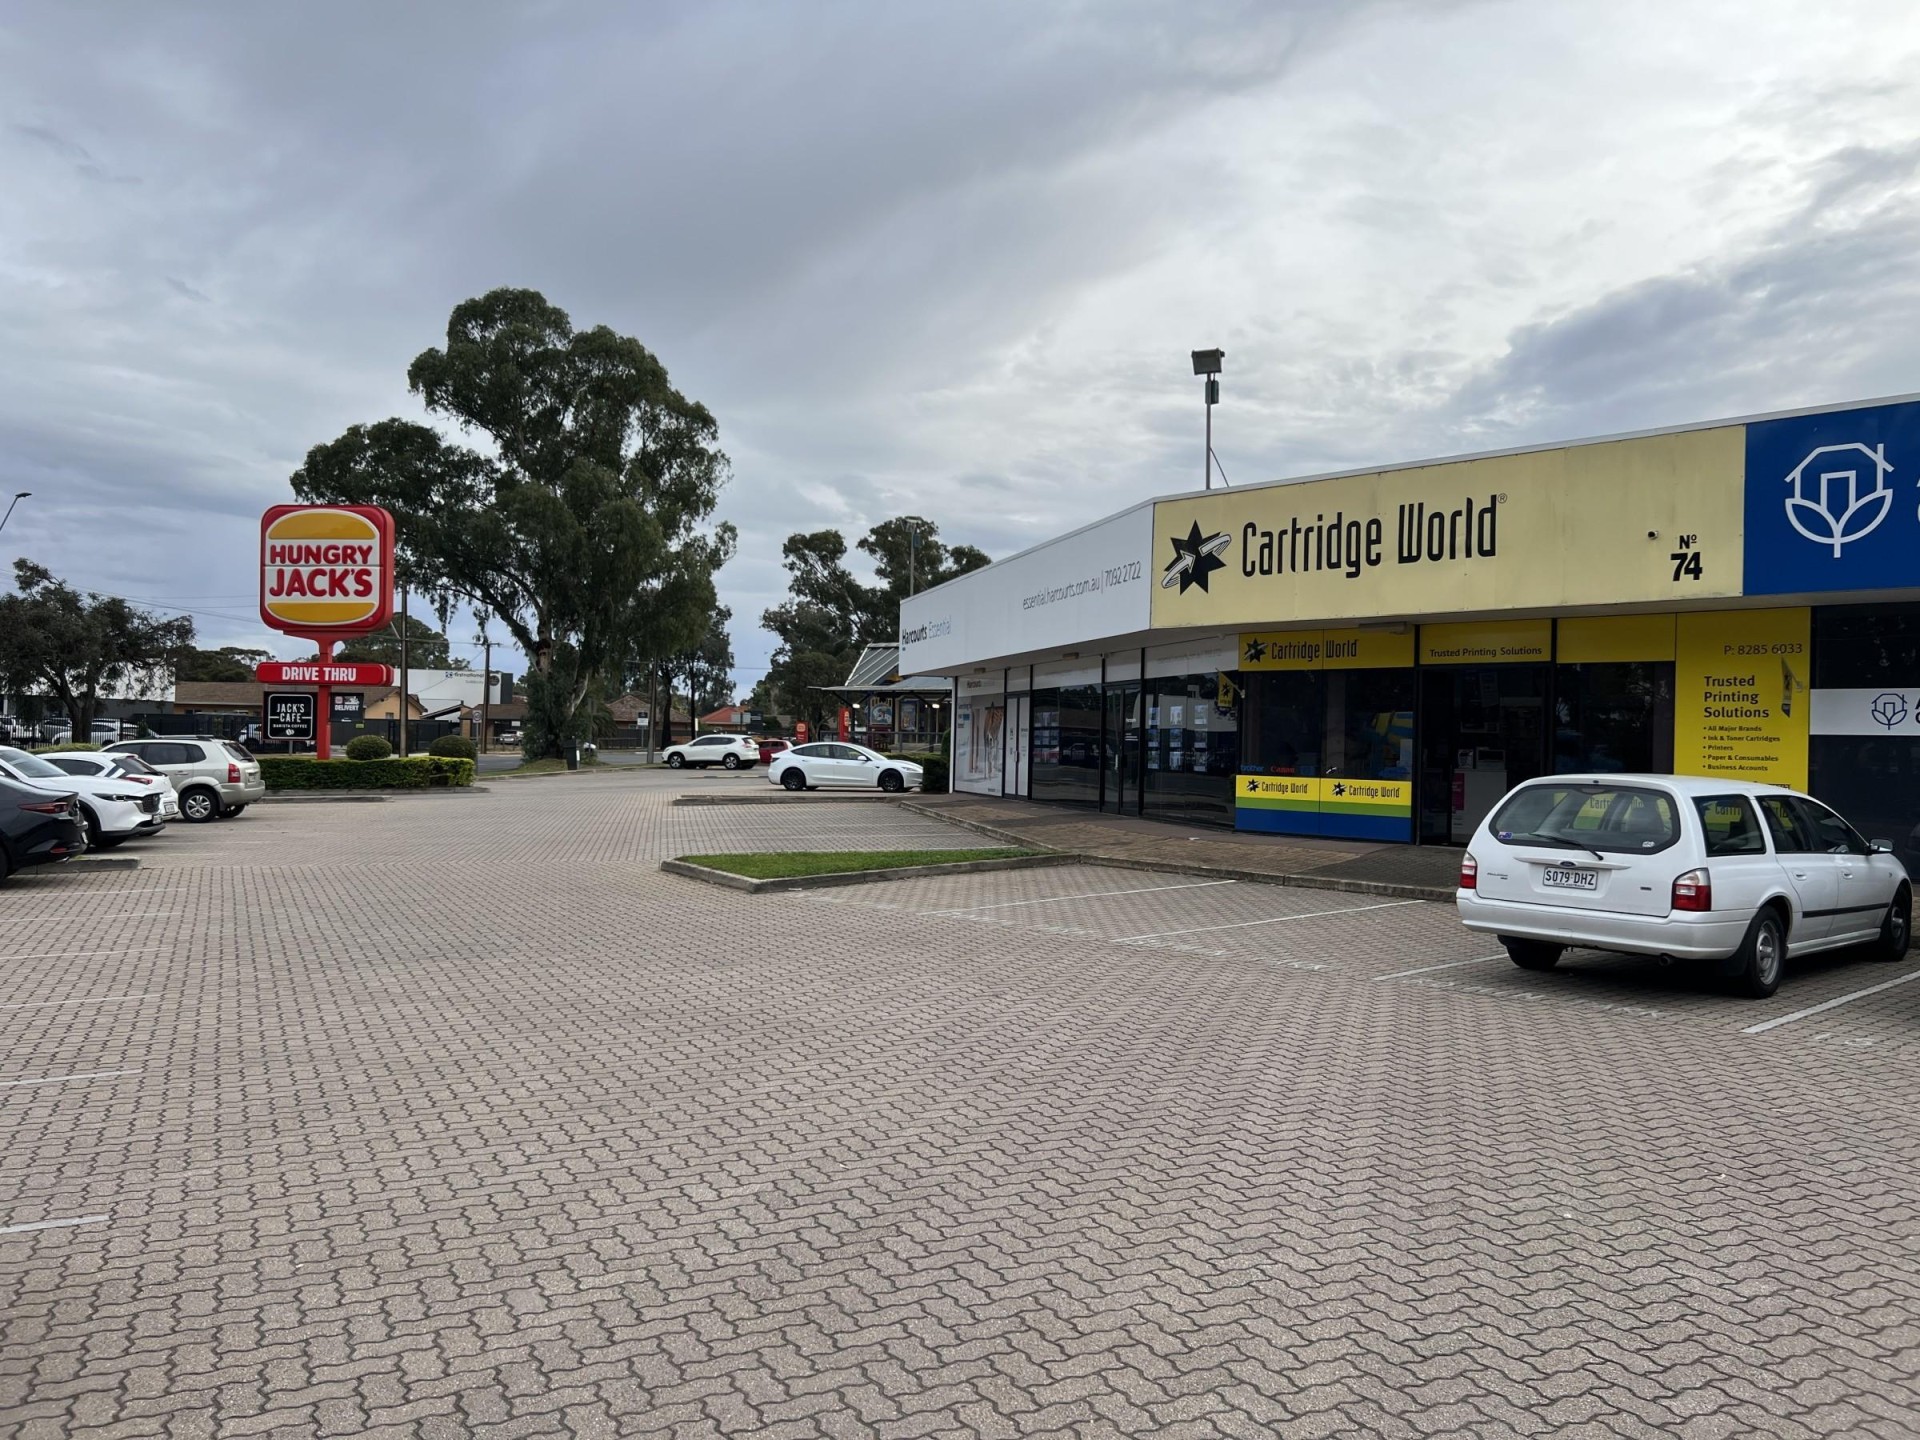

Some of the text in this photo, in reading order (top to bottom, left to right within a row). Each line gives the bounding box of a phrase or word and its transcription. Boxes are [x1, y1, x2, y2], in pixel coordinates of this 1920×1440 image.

[1242, 511, 1382, 579] Cartridge
[270, 544, 373, 565] HUNGRY
[1104, 566, 1122, 588] 7092
[1123, 560, 1142, 582] 2722
[1670, 551, 1703, 582] 74
[269, 568, 373, 598] JACK'S
[902, 624, 928, 645] Harcourts
[1271, 639, 1358, 662] Cartridge World
[1430, 646, 1542, 658] Trusted Printing Solutions
[1738, 644, 1768, 656] 8285
[1771, 643, 1803, 655] 6033
[282, 666, 357, 682] DRIVE THRU
[1704, 675, 1755, 687] Trusted
[1704, 691, 1760, 705] Printing
[276, 703, 305, 713] JACK'S
[1704, 706, 1770, 718] Solutions
[280, 713, 301, 723] CAFE
[1261, 782, 1308, 794] Cartridge World
[1348, 785, 1400, 799] Cartridge World
[1545, 870, 1595, 886] S079 DHZ
